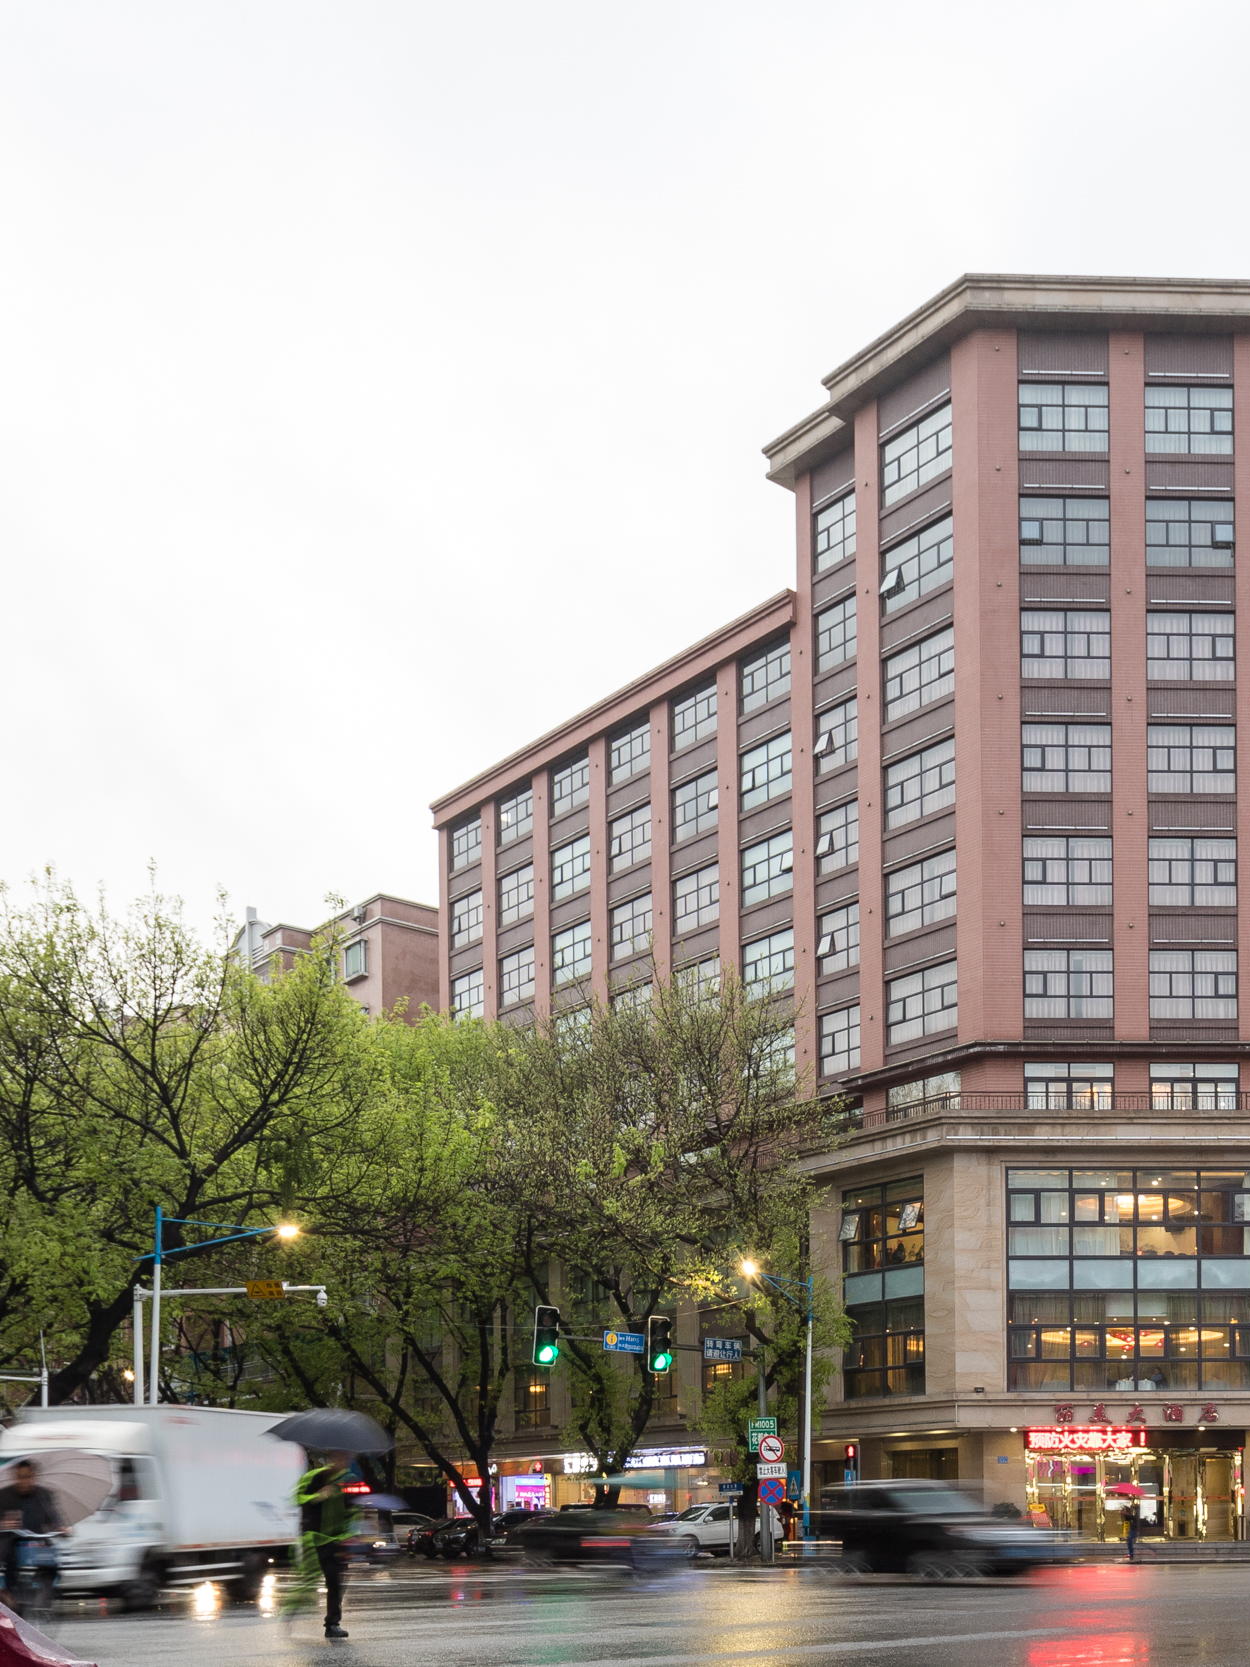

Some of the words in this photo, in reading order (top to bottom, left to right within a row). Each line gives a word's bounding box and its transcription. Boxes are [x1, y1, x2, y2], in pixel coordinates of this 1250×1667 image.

[1053, 1402, 1219, 1424] 丽美大酒店
